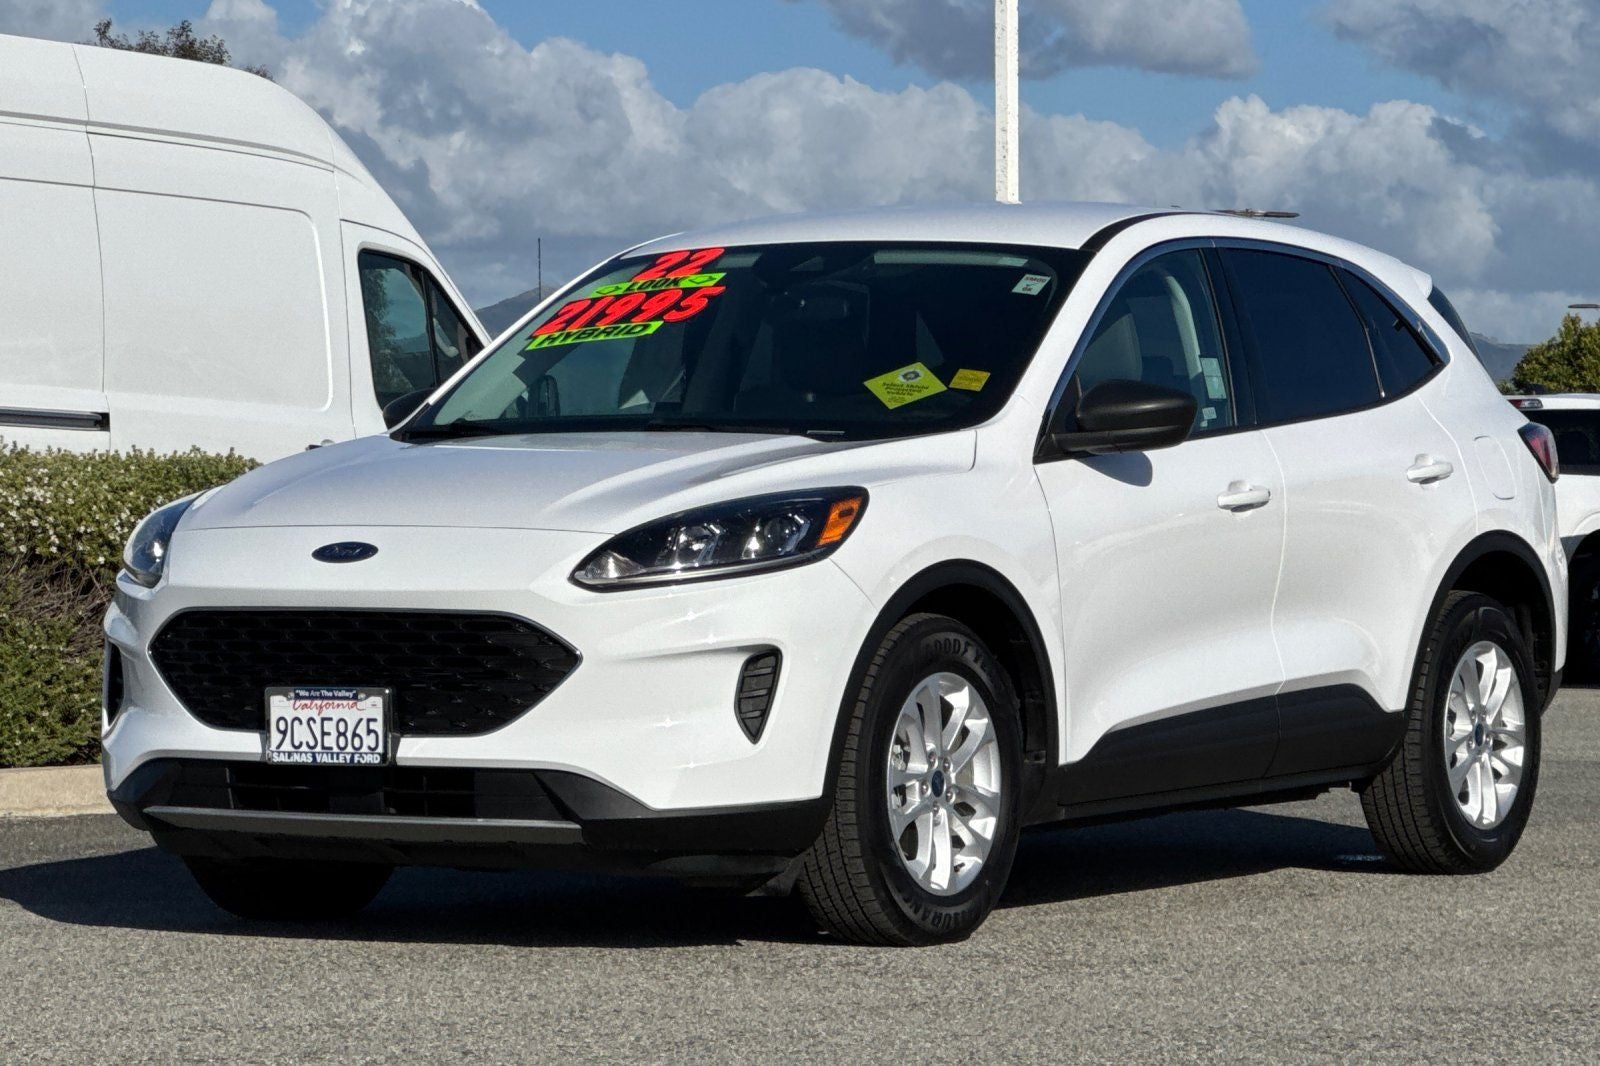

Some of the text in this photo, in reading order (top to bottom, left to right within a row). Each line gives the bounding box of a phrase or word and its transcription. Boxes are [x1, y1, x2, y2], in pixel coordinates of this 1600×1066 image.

[632, 247, 725, 282] 22
[626, 276, 682, 292] LOOK
[531, 286, 728, 338] 21995
[537, 324, 648, 347] HYBRID
[321, 690, 333, 698] The
[333, 690, 357, 699] Valley"
[292, 700, 366, 716] California
[275, 716, 380, 752] 9CSE865
[315, 753, 352, 763] VALLEY
[353, 753, 381, 764] FORD
